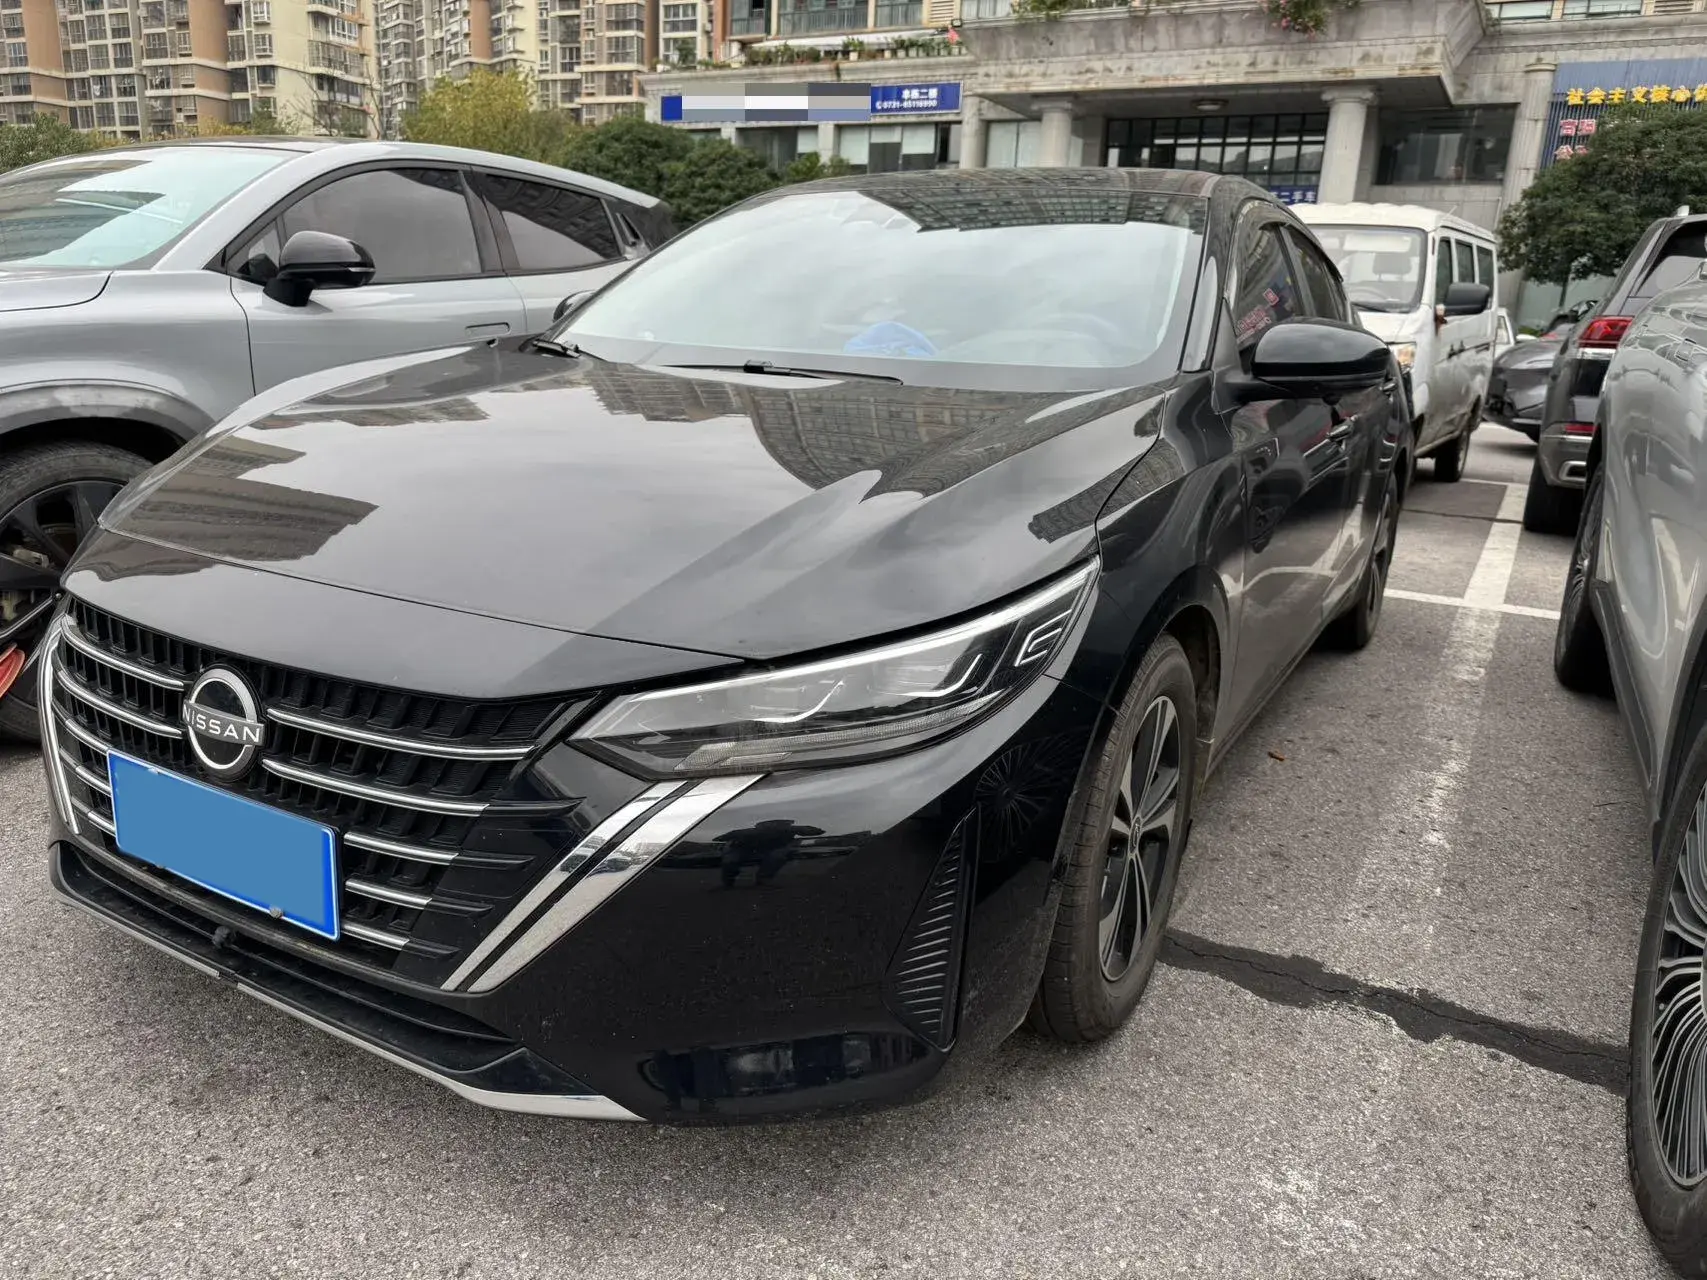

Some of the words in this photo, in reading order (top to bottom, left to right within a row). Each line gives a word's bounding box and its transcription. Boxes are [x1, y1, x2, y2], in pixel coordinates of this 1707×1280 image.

[1271, 191, 1317, 203] 二手车
[183, 703, 260, 743] NISSAN
